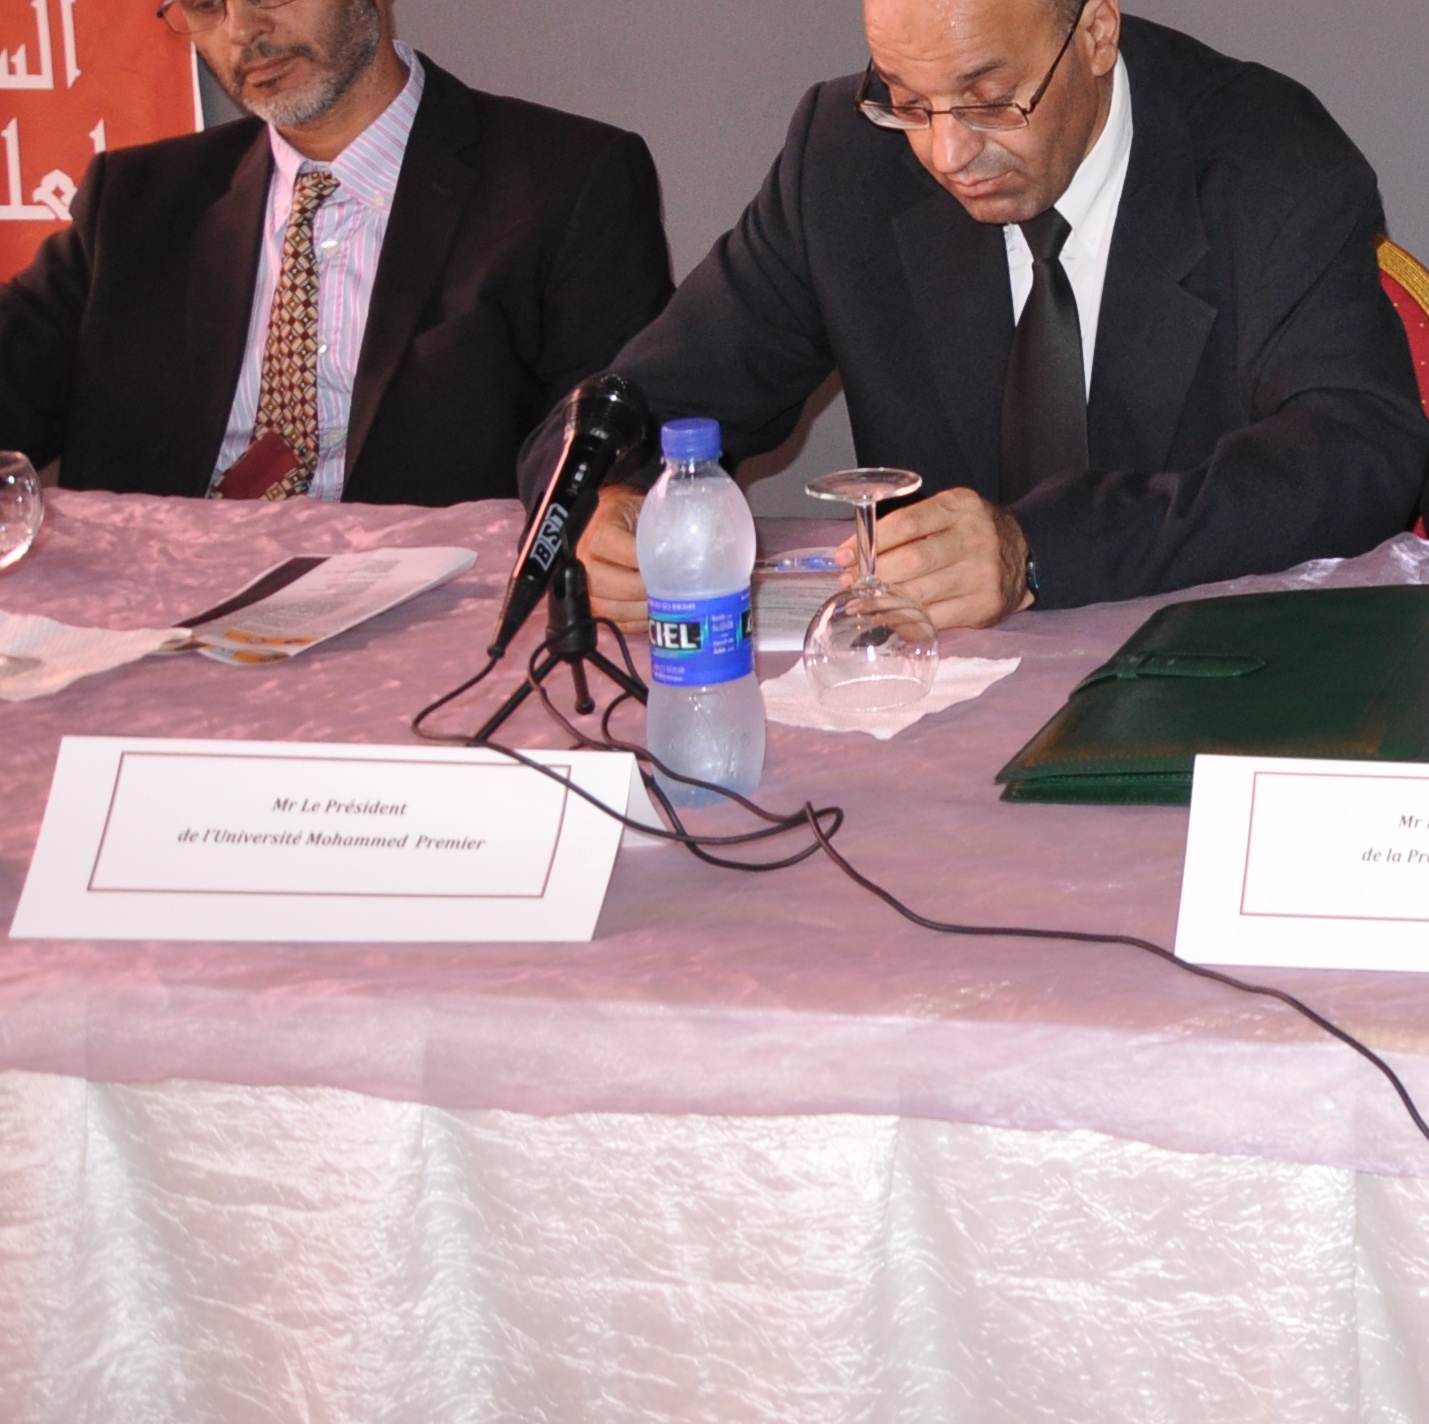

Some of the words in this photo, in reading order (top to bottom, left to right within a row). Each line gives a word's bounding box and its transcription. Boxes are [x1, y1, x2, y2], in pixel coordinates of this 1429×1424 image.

[272, 797, 297, 814] Mr
[300, 797, 322, 815] Le
[324, 796, 409, 817] Président
[1398, 814, 1423, 830] Mr
[177, 827, 200, 844] de
[202, 827, 304, 847] l'Université
[306, 830, 410, 850] Mohammed
[415, 834, 488, 852] Premier
[1361, 847, 1382, 863] de
[1386, 847, 1402, 864] la
